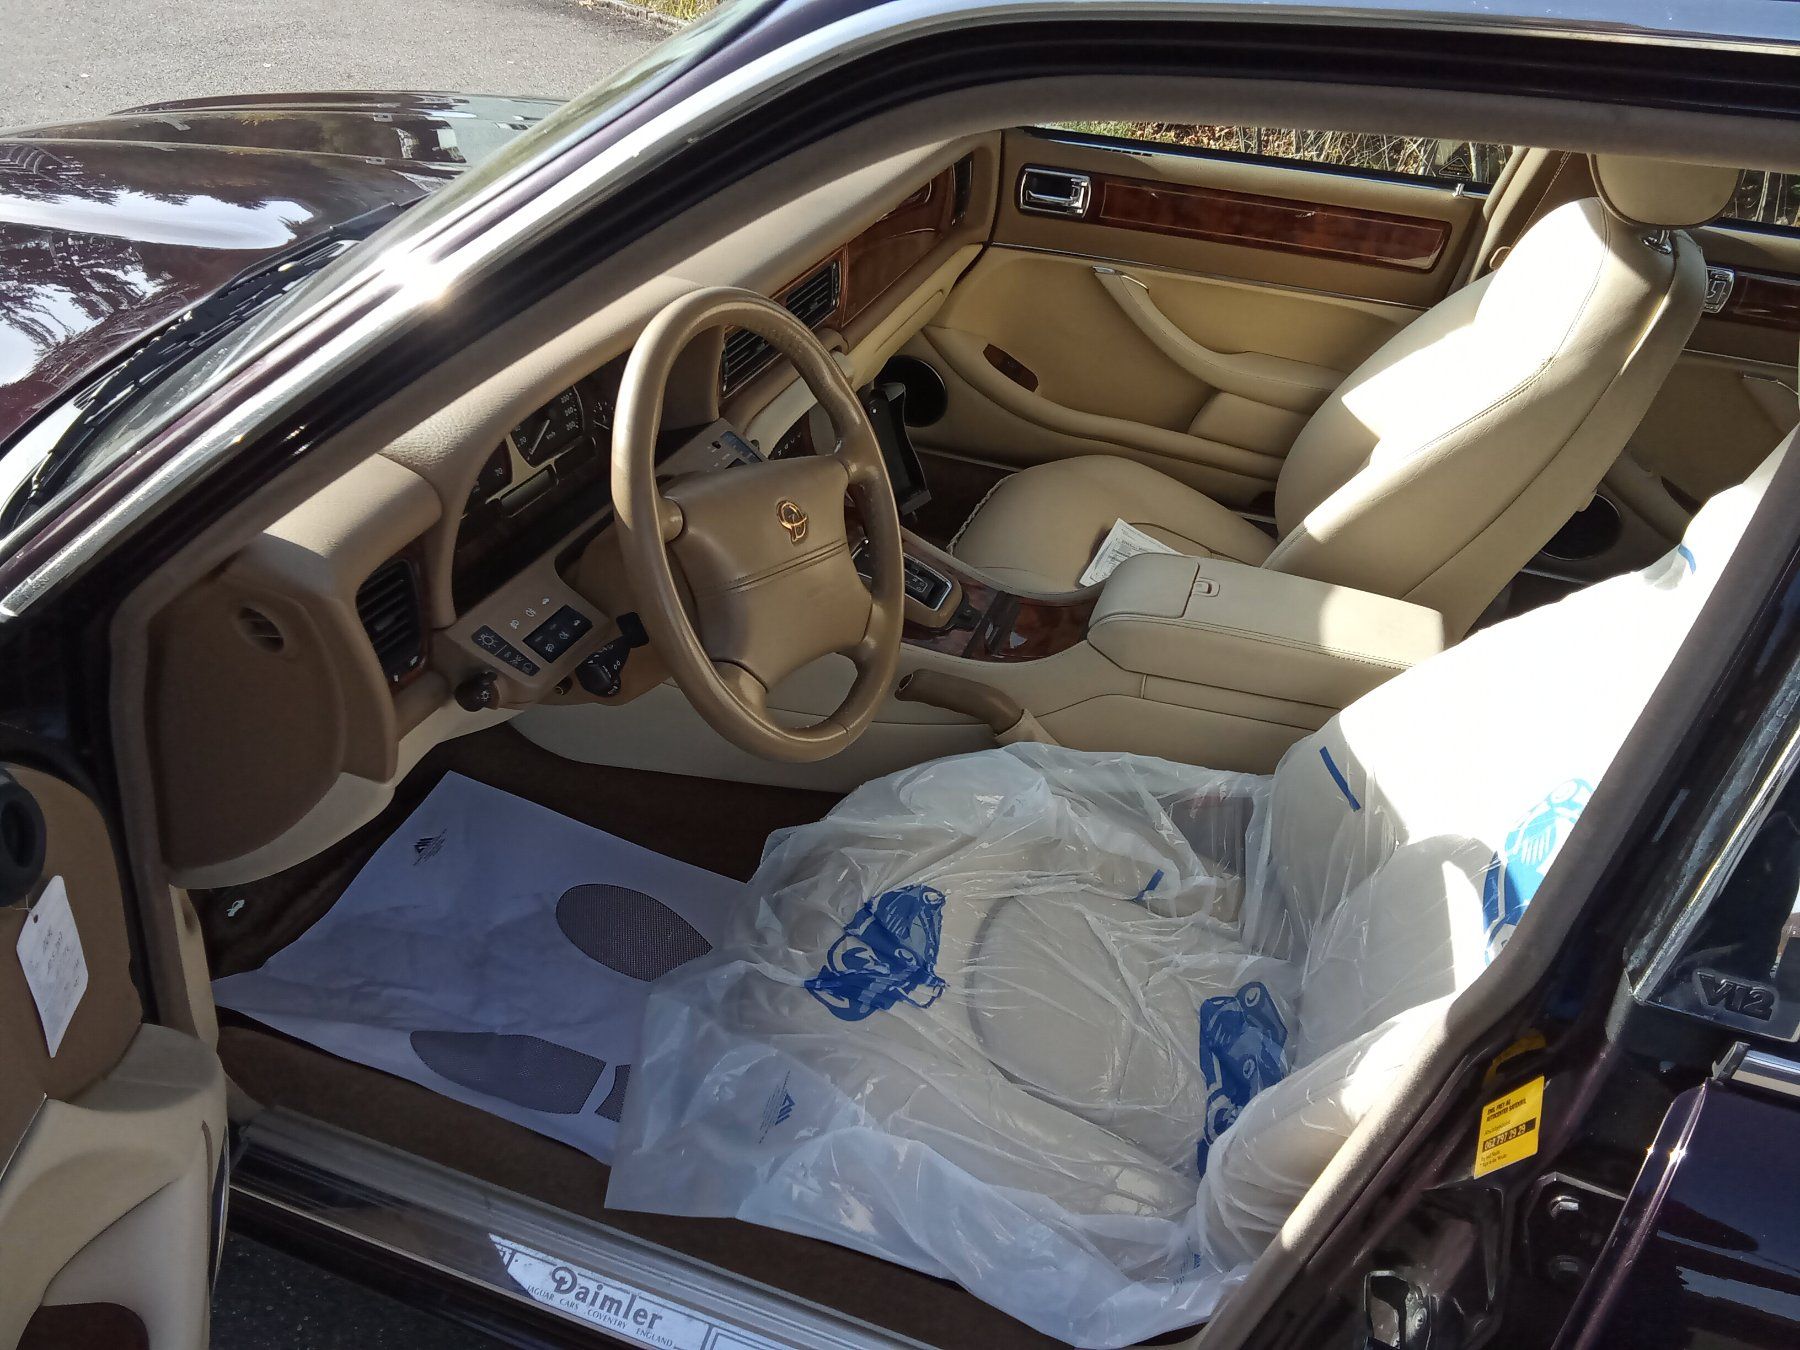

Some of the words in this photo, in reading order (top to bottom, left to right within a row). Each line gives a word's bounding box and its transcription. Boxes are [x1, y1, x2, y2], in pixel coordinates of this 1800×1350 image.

[1697, 972, 1774, 1021] V12
[527, 1285, 555, 1301] JAGUAR
[560, 1298, 579, 1310] CARS
[588, 1309, 628, 1329] COVENTRY
[636, 1328, 673, 1347] ENGLAND
[551, 1266, 663, 1330] Daimler
